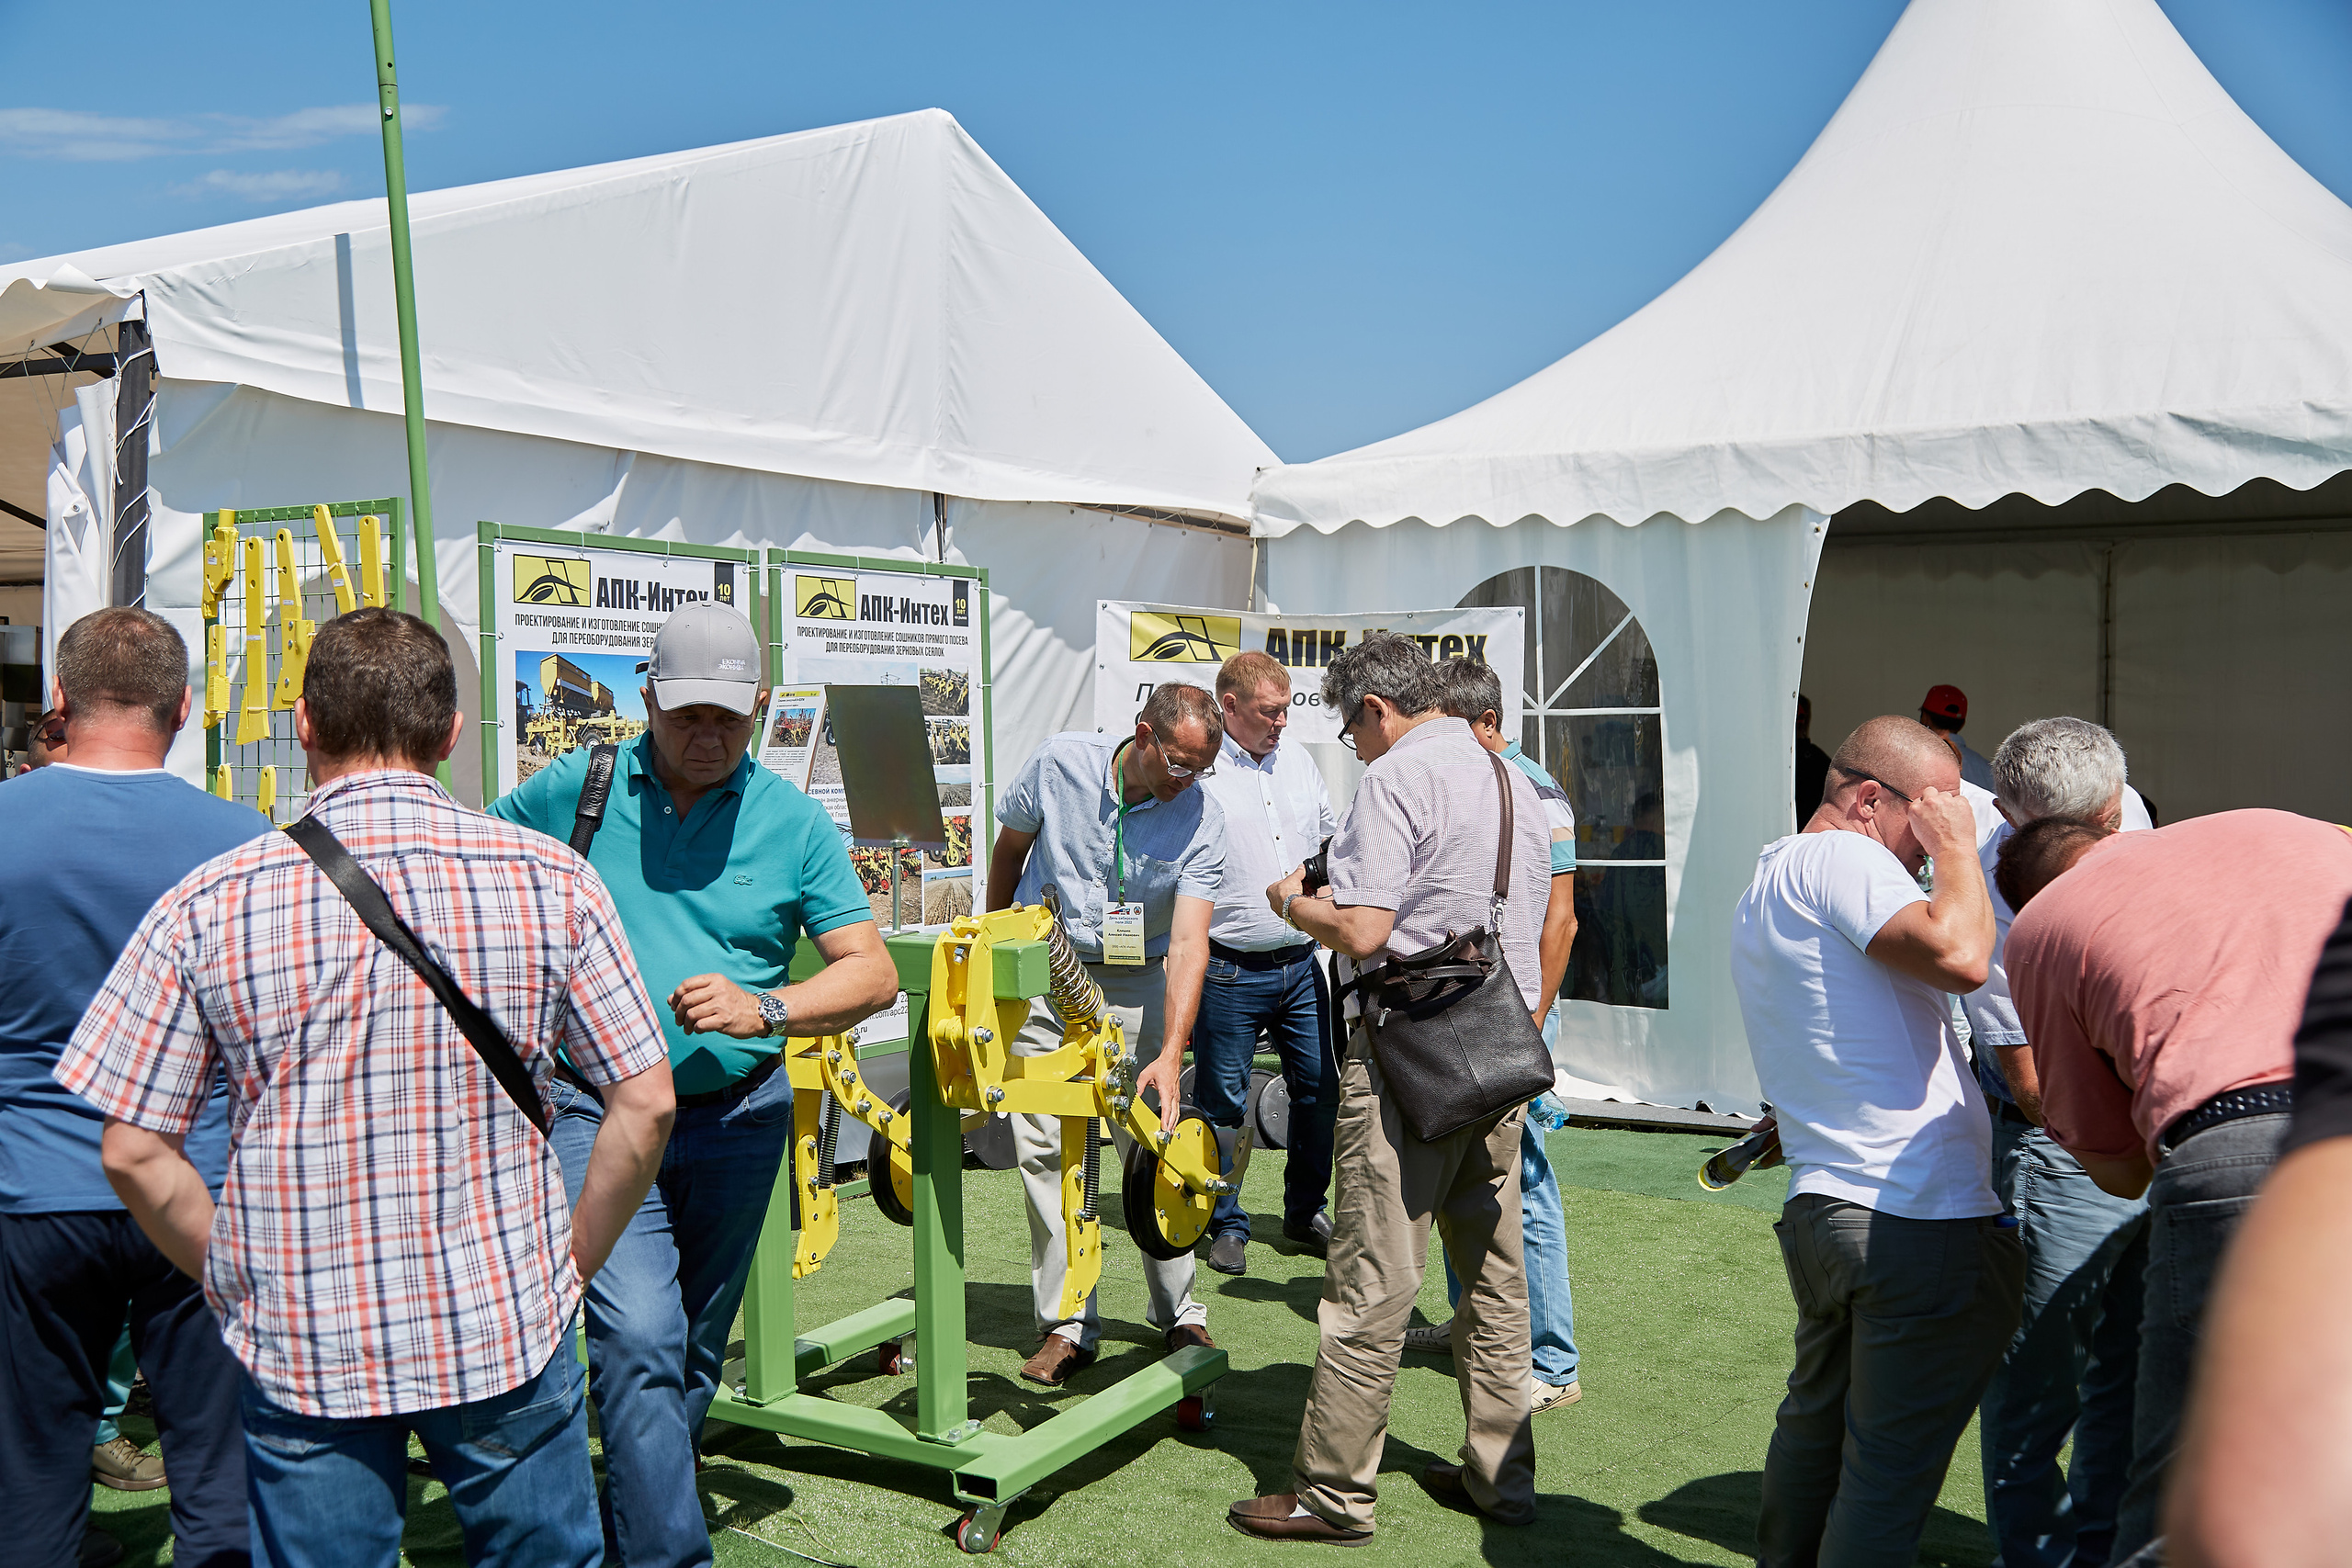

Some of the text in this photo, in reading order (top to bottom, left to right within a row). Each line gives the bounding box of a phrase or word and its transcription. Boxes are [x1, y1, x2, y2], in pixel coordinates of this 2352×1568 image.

[718, 582, 731, 596] 10
[860, 594, 949, 626] АПК-Интех
[956, 598, 967, 609] 10
[514, 614, 581, 629] ПРОЕКТИРОВАНИЕ
[582, 617, 587, 629] И
[588, 618, 640, 633] ИЗГОТОВЛЕНИЕ
[551, 631, 568, 645] ДЛЯ
[569, 632, 640, 648] ПЕРЕОБОРУДОВАНИЯ
[797, 626, 969, 646] ПРОЕКТИРОВАНИЕ И ИЗГОТОВЛЕНИЕ СОШНИКОВ ПРЯМОГО ПОСЕВА
[825, 641, 945, 657] ДЛЯ ПЕРЕОБОРУДОВАНИЯ ЗЕРНОВЫХ СЕЯЛОК
[1265, 627, 1488, 668] АПК-тех
